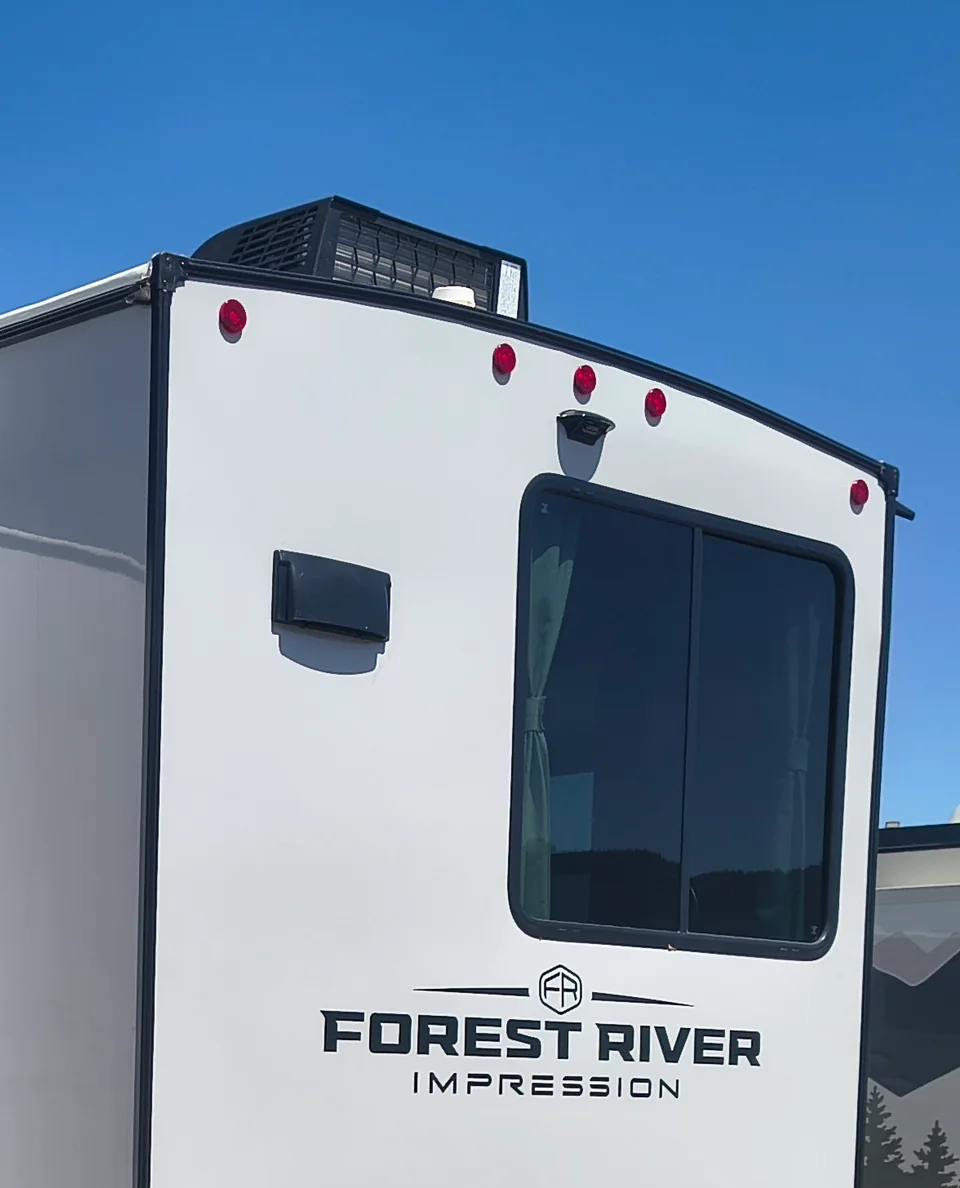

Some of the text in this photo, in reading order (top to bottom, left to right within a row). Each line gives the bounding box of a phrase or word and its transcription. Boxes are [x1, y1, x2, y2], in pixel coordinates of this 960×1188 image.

[542, 970, 579, 1009] FR
[320, 1010, 761, 1067] FOREST RIVER
[413, 1071, 680, 1099] IMPRESSION
